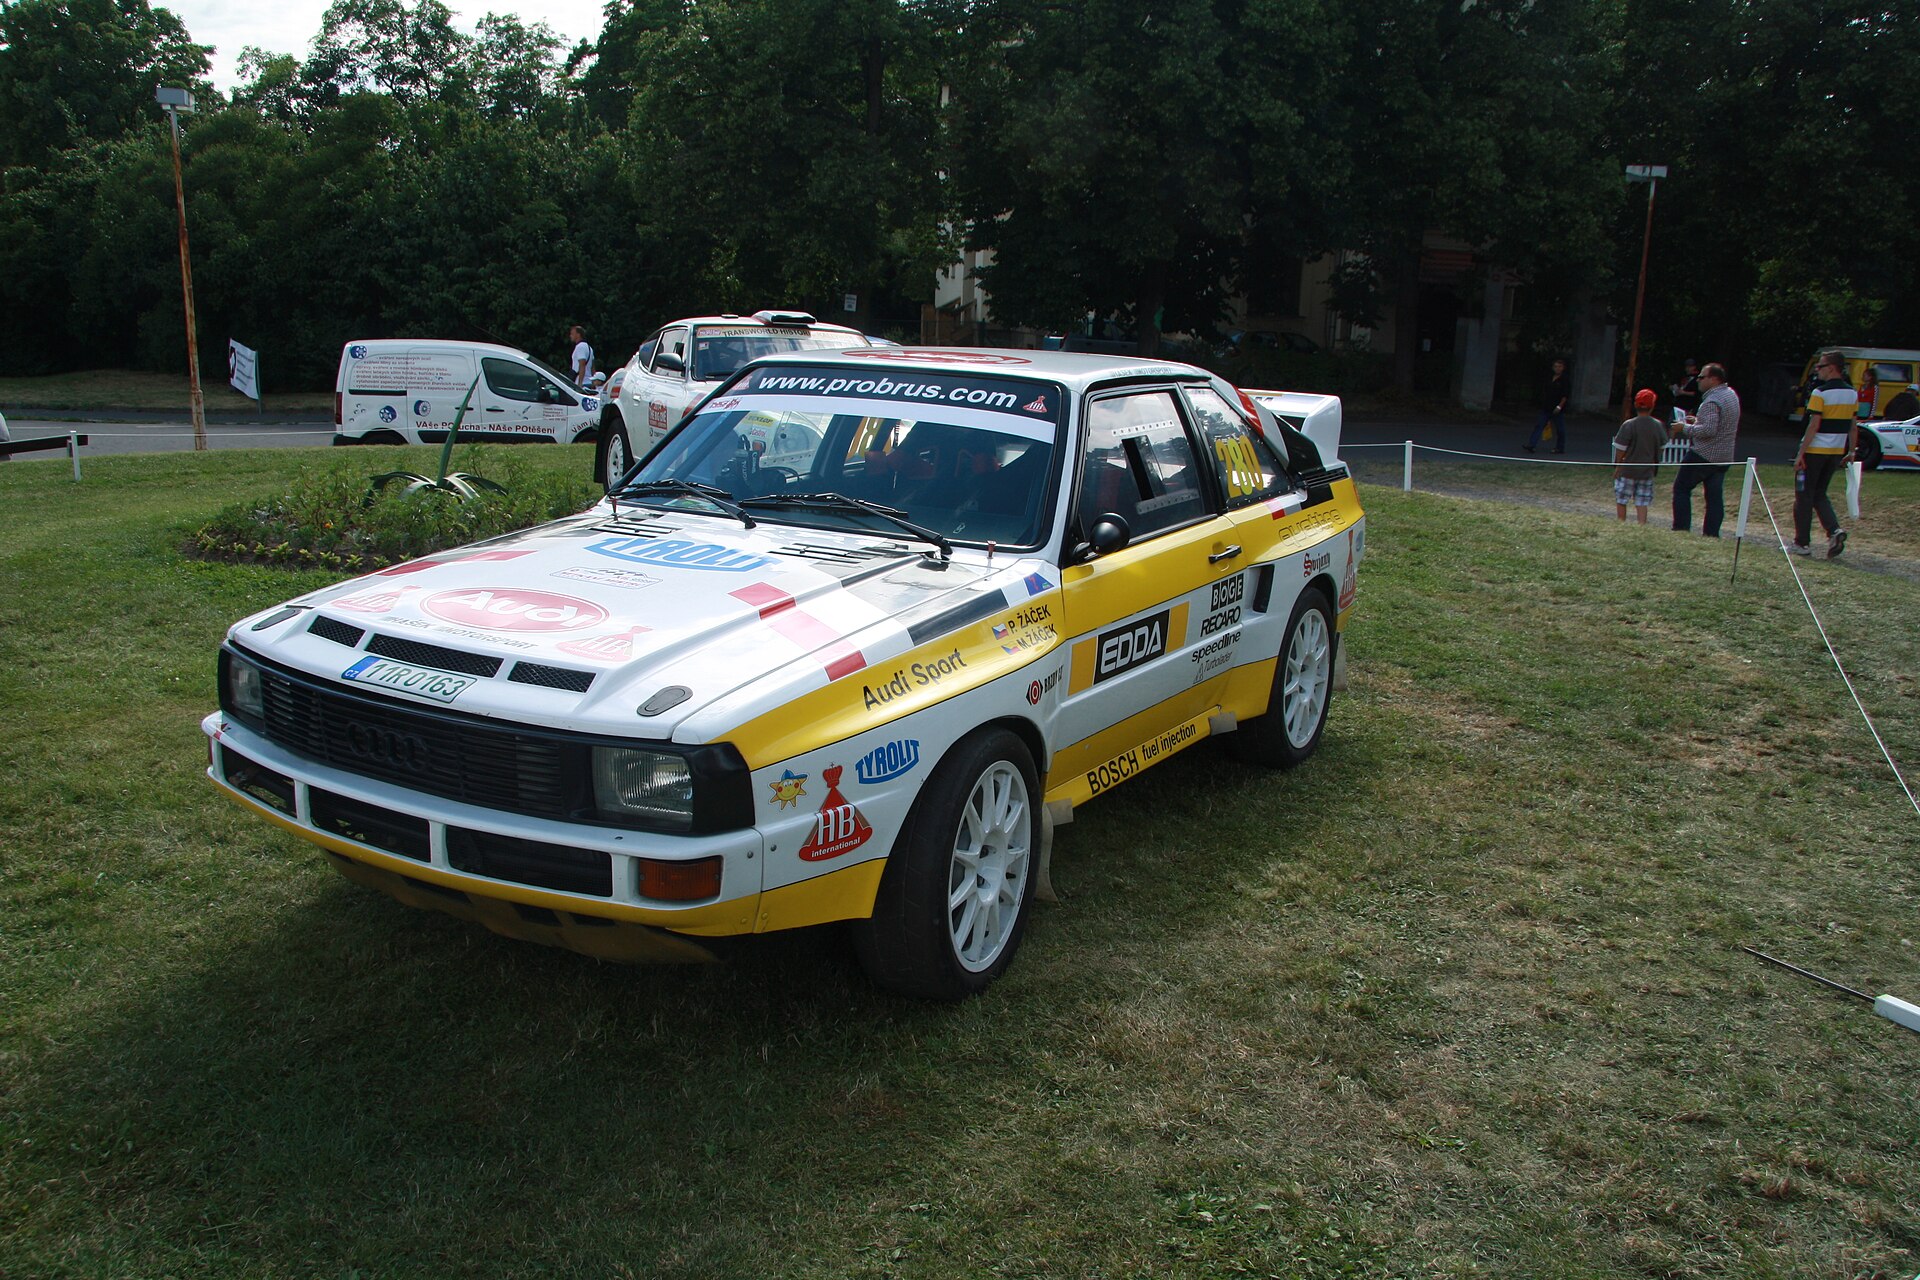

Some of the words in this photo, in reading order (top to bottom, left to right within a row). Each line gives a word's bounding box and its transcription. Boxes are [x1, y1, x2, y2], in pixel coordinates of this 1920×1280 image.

[722, 328, 778, 337] TRANSWORLD
[758, 375, 1018, 408] www.probrus.com
[1215, 434, 1264, 498] 280
[583, 537, 784, 572] TYROLIT
[431, 590, 597, 628] Audi
[1212, 577, 1244, 607] BOGE
[1008, 619, 1018, 634] P.
[1016, 604, 1051, 629] ŽÁČEK
[1200, 605, 1241, 637] RECARO
[436, 625, 539, 650] MOTORSPORT
[1100, 620, 1162, 675] EDDA
[1191, 630, 1241, 664] speedline
[344, 669, 360, 677] CZ
[862, 669, 912, 712] Audi
[911, 647, 968, 685] Sport
[855, 739, 920, 784] TYROLIT
[1086, 750, 1139, 795] BOSCH
[1141, 739, 1160, 761] fuel
[1159, 723, 1197, 752] injection
[815, 803, 856, 846] HB
[811, 837, 860, 858] international
